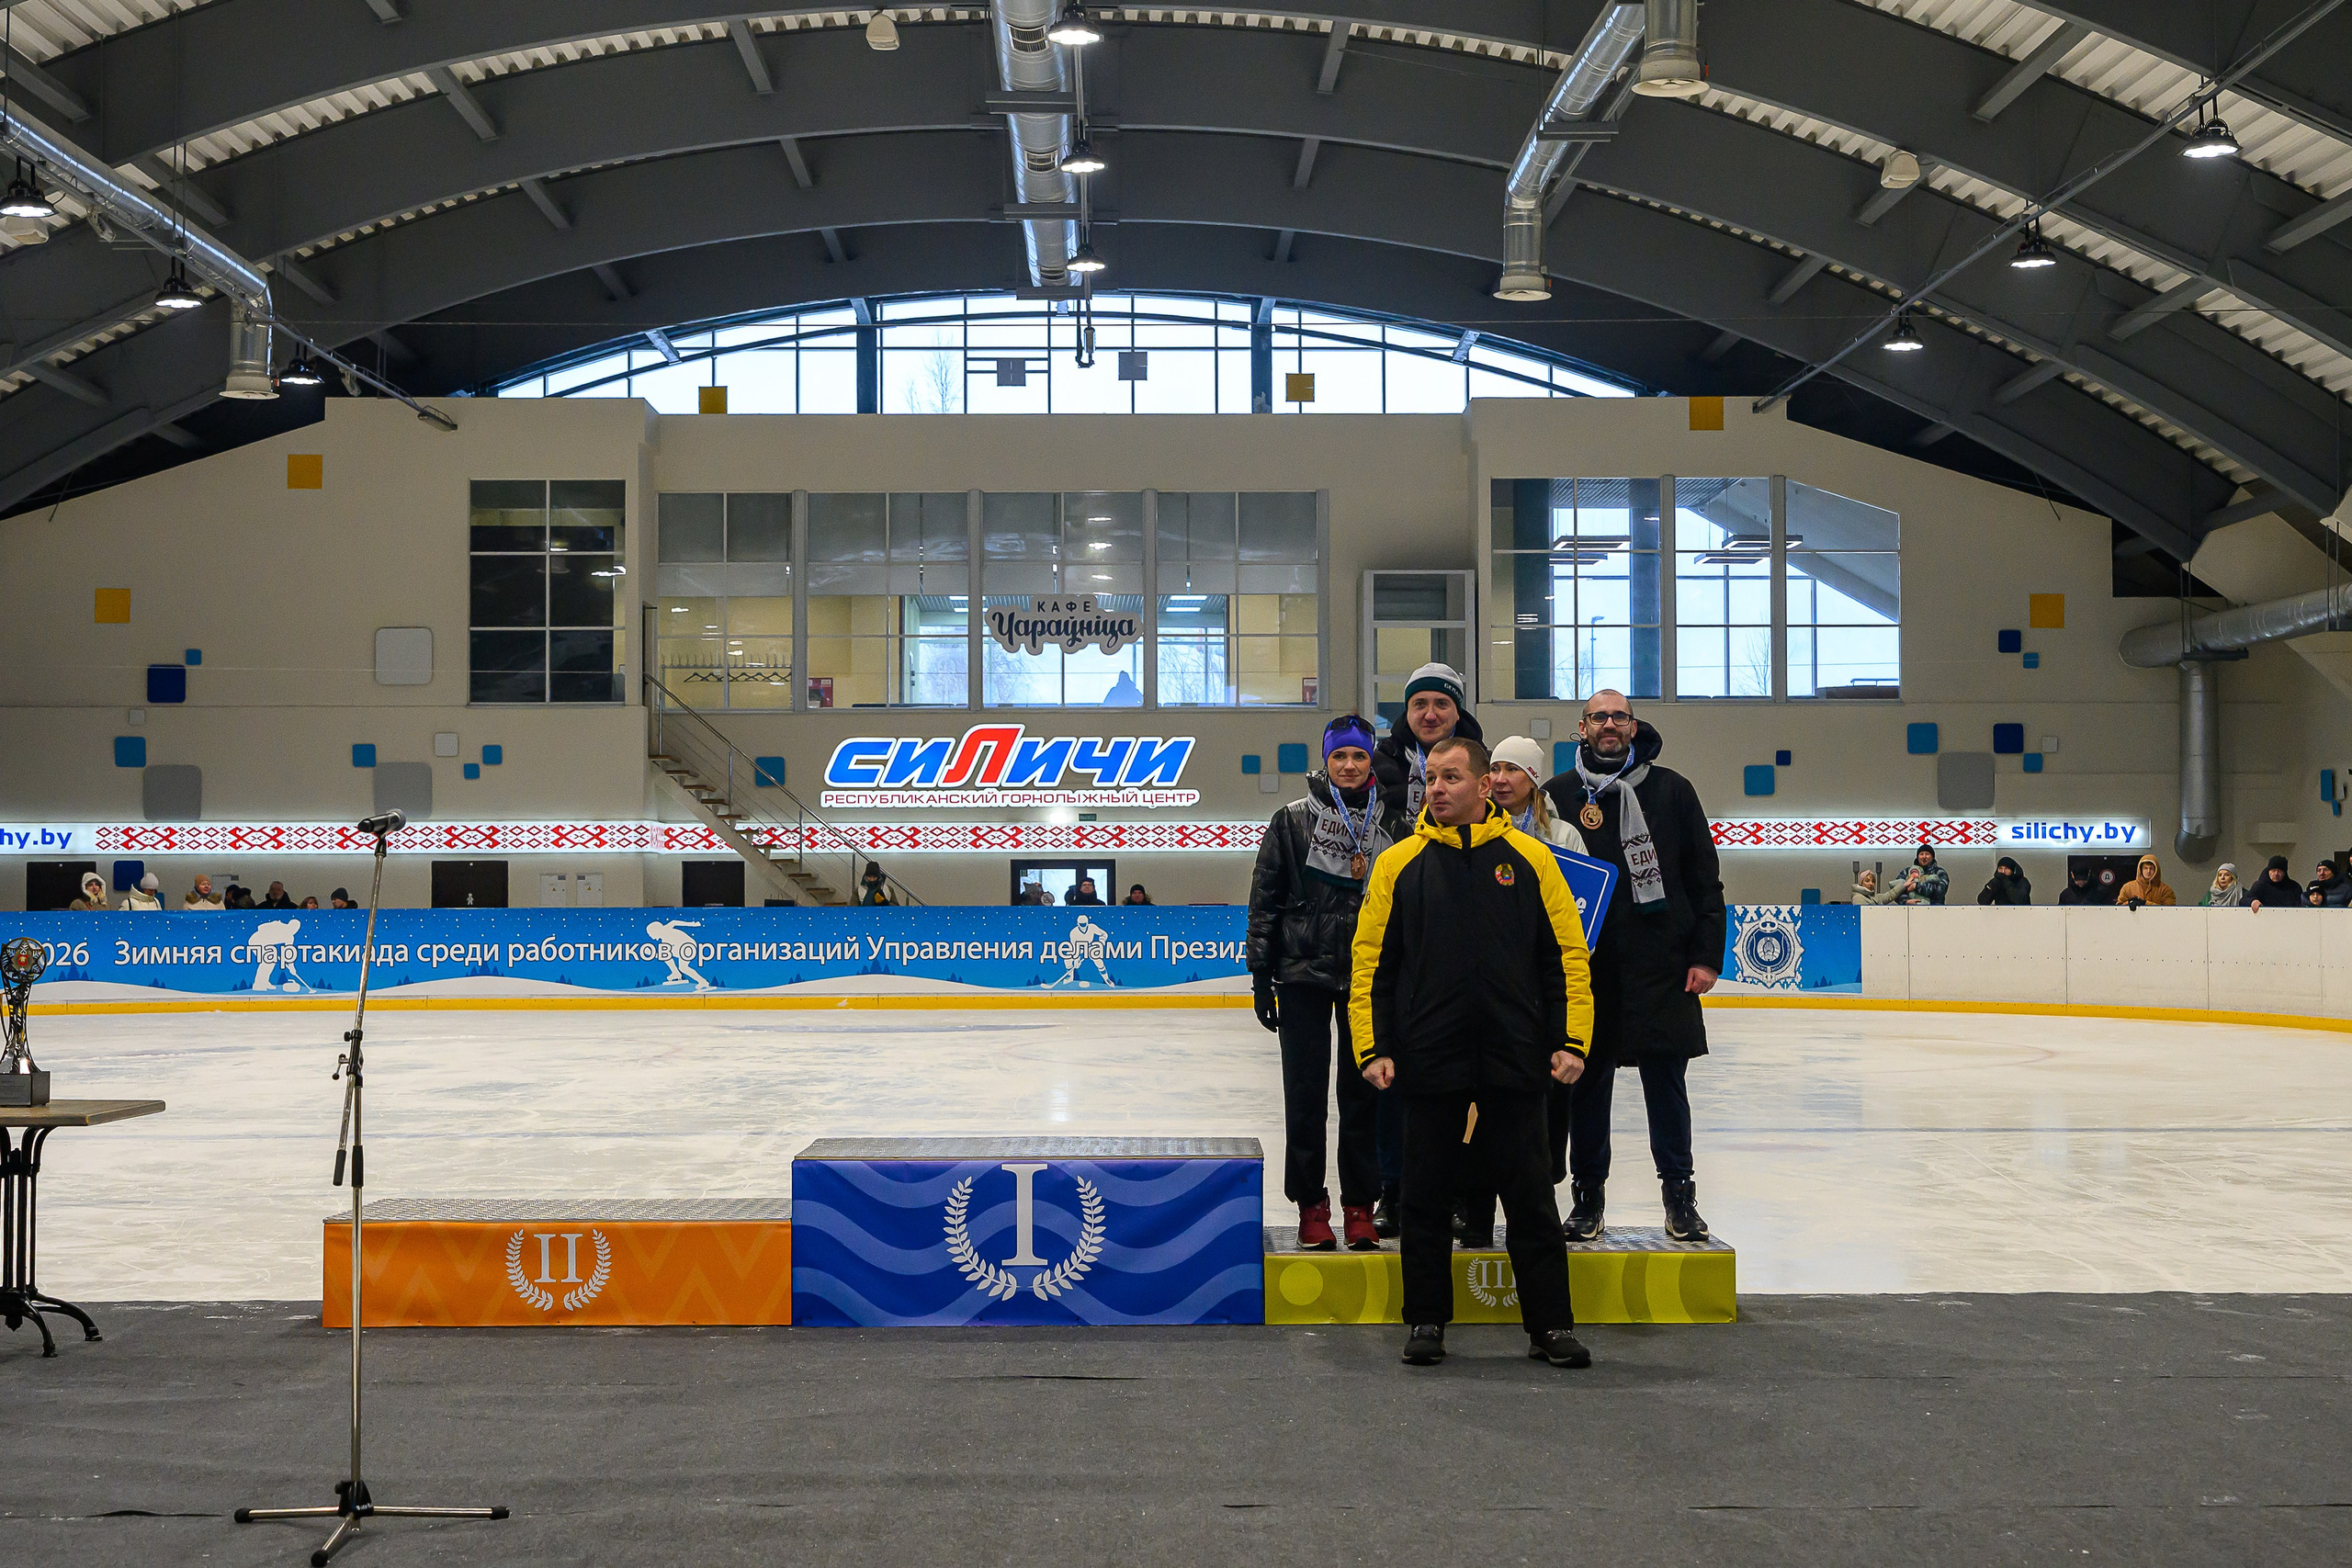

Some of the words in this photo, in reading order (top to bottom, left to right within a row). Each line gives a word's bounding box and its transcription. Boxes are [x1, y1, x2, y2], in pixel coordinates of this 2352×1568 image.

[1036, 601, 1091, 613] КАФЕ
[825, 791, 998, 805] РЕСПУБЛИКАНСКИЙ
[1001, 791, 1138, 805] ГОРНОЛЫЖНЫЙ
[1142, 793, 1196, 807] ЦЕНТР
[2011, 822, 2137, 843] silichy.by
[40, 942, 90, 966] 026
[113, 940, 222, 965] Зимняя
[230, 942, 409, 968] спартакиада
[416, 942, 501, 968] среди
[507, 935, 674, 968] работников
[678, 936, 860, 967] организаций
[866, 935, 1034, 966] Управления
[1039, 940, 1143, 963] делами
